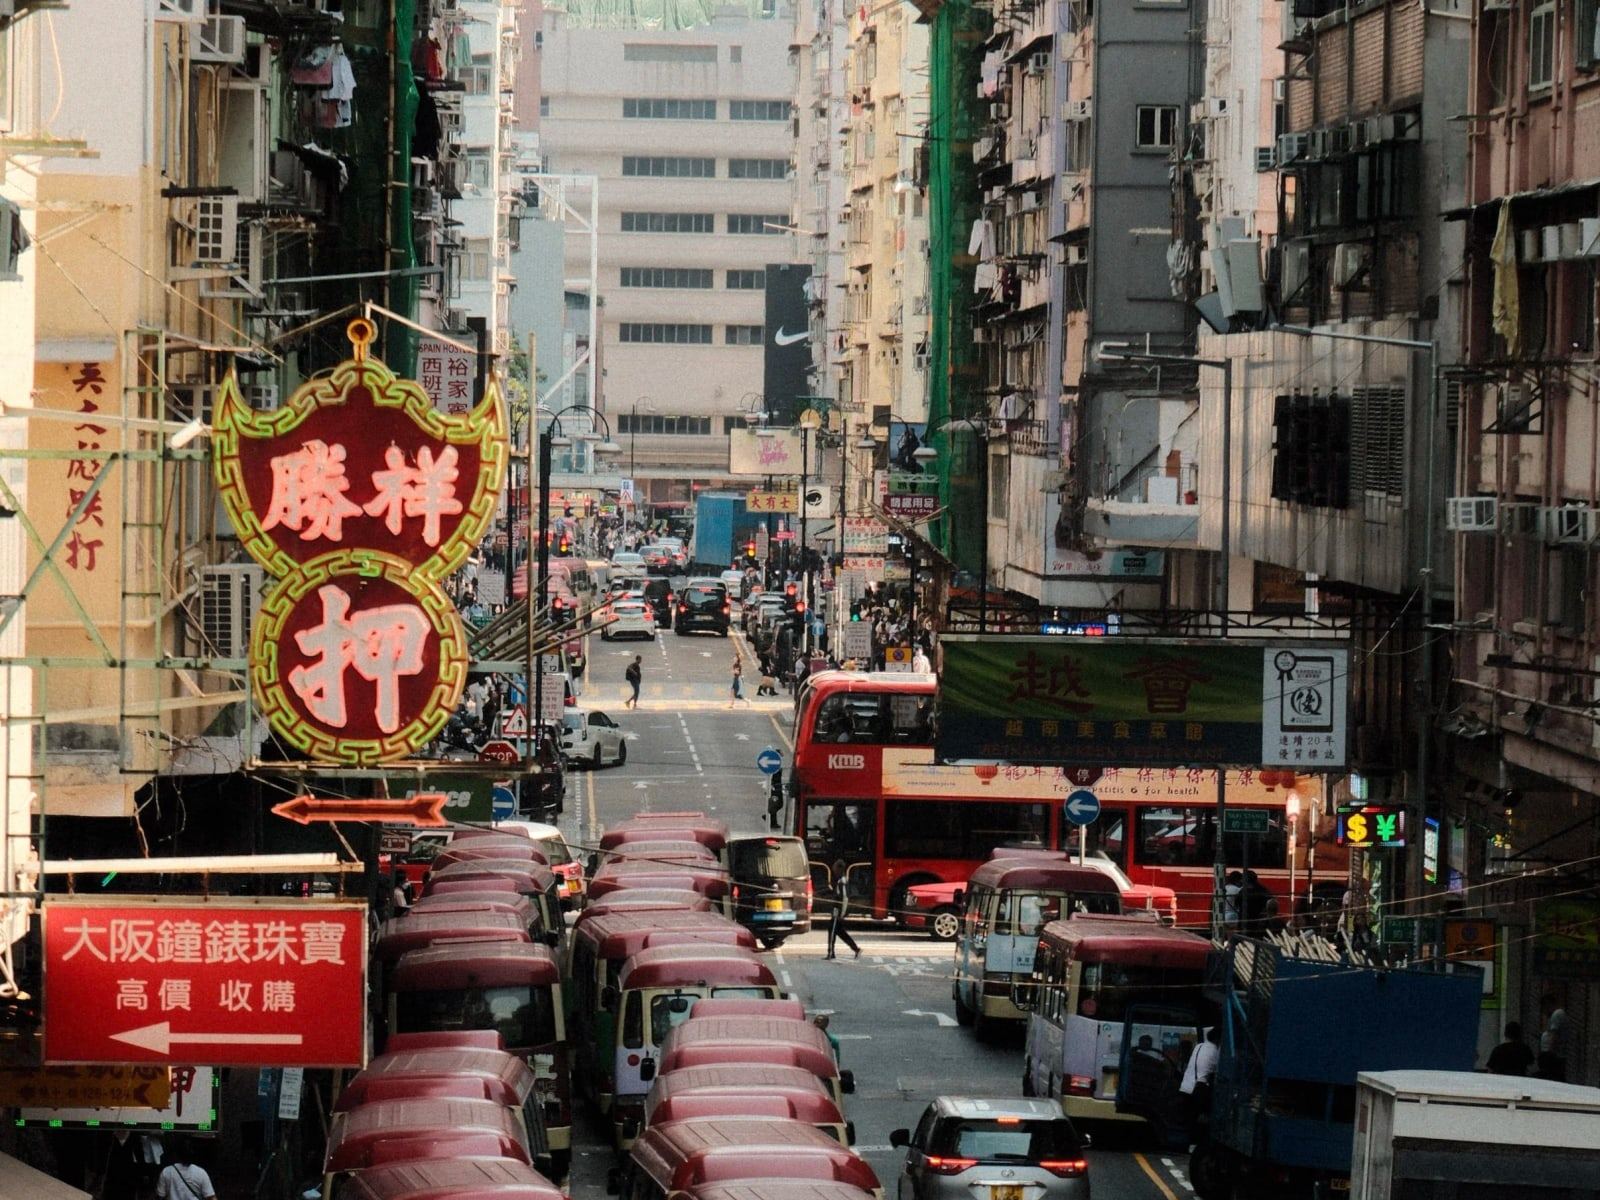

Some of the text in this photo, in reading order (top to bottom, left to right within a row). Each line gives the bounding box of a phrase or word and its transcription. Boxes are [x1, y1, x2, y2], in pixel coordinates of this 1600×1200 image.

[419, 343, 473, 354] SPAIN HOST
[751, 495, 798, 510] 大有士
[287, 584, 431, 734] 押
[828, 754, 865, 769] KMB
[1145, 785, 1161, 796] for
[1167, 786, 1199, 796] health
[61, 918, 346, 966] 大阪鐘錶珠寶
[116, 978, 297, 1013] 高價 收購
